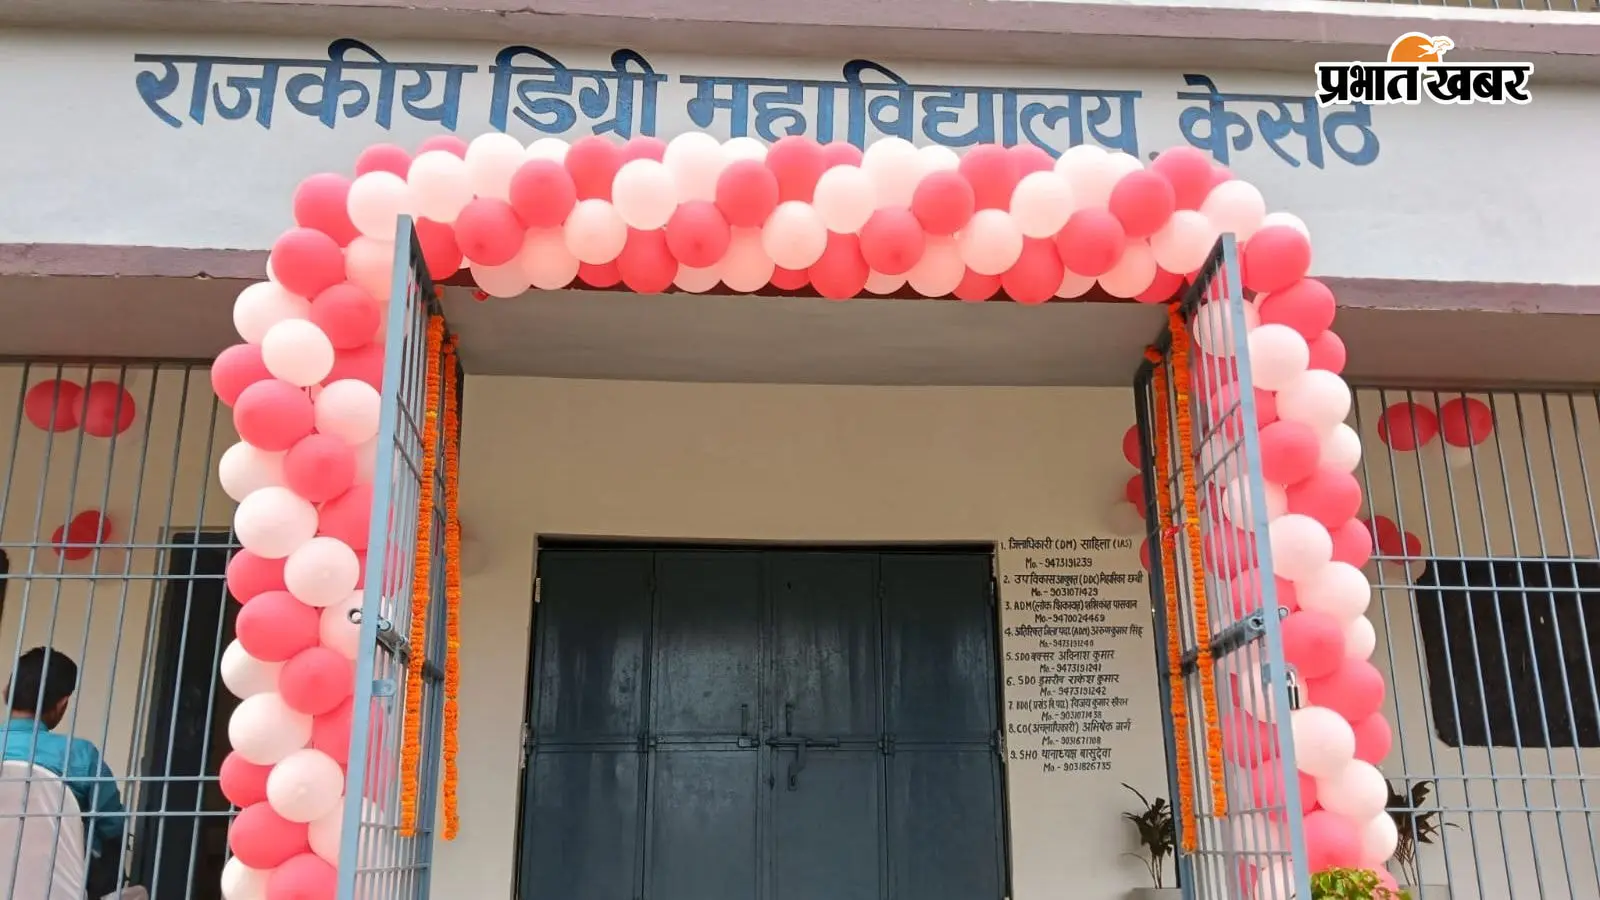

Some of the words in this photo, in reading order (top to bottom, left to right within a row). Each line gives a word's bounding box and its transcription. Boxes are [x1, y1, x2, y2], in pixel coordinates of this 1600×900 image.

[134, 38, 478, 130] राजकीय
[488, 45, 667, 137] डिग्री
[1176, 73, 1381, 170] केसठ
[1055, 538, 1077, 551] (DM)
[1018, 675, 1036, 685] SDO
[1019, 750, 1038, 760] SHO
